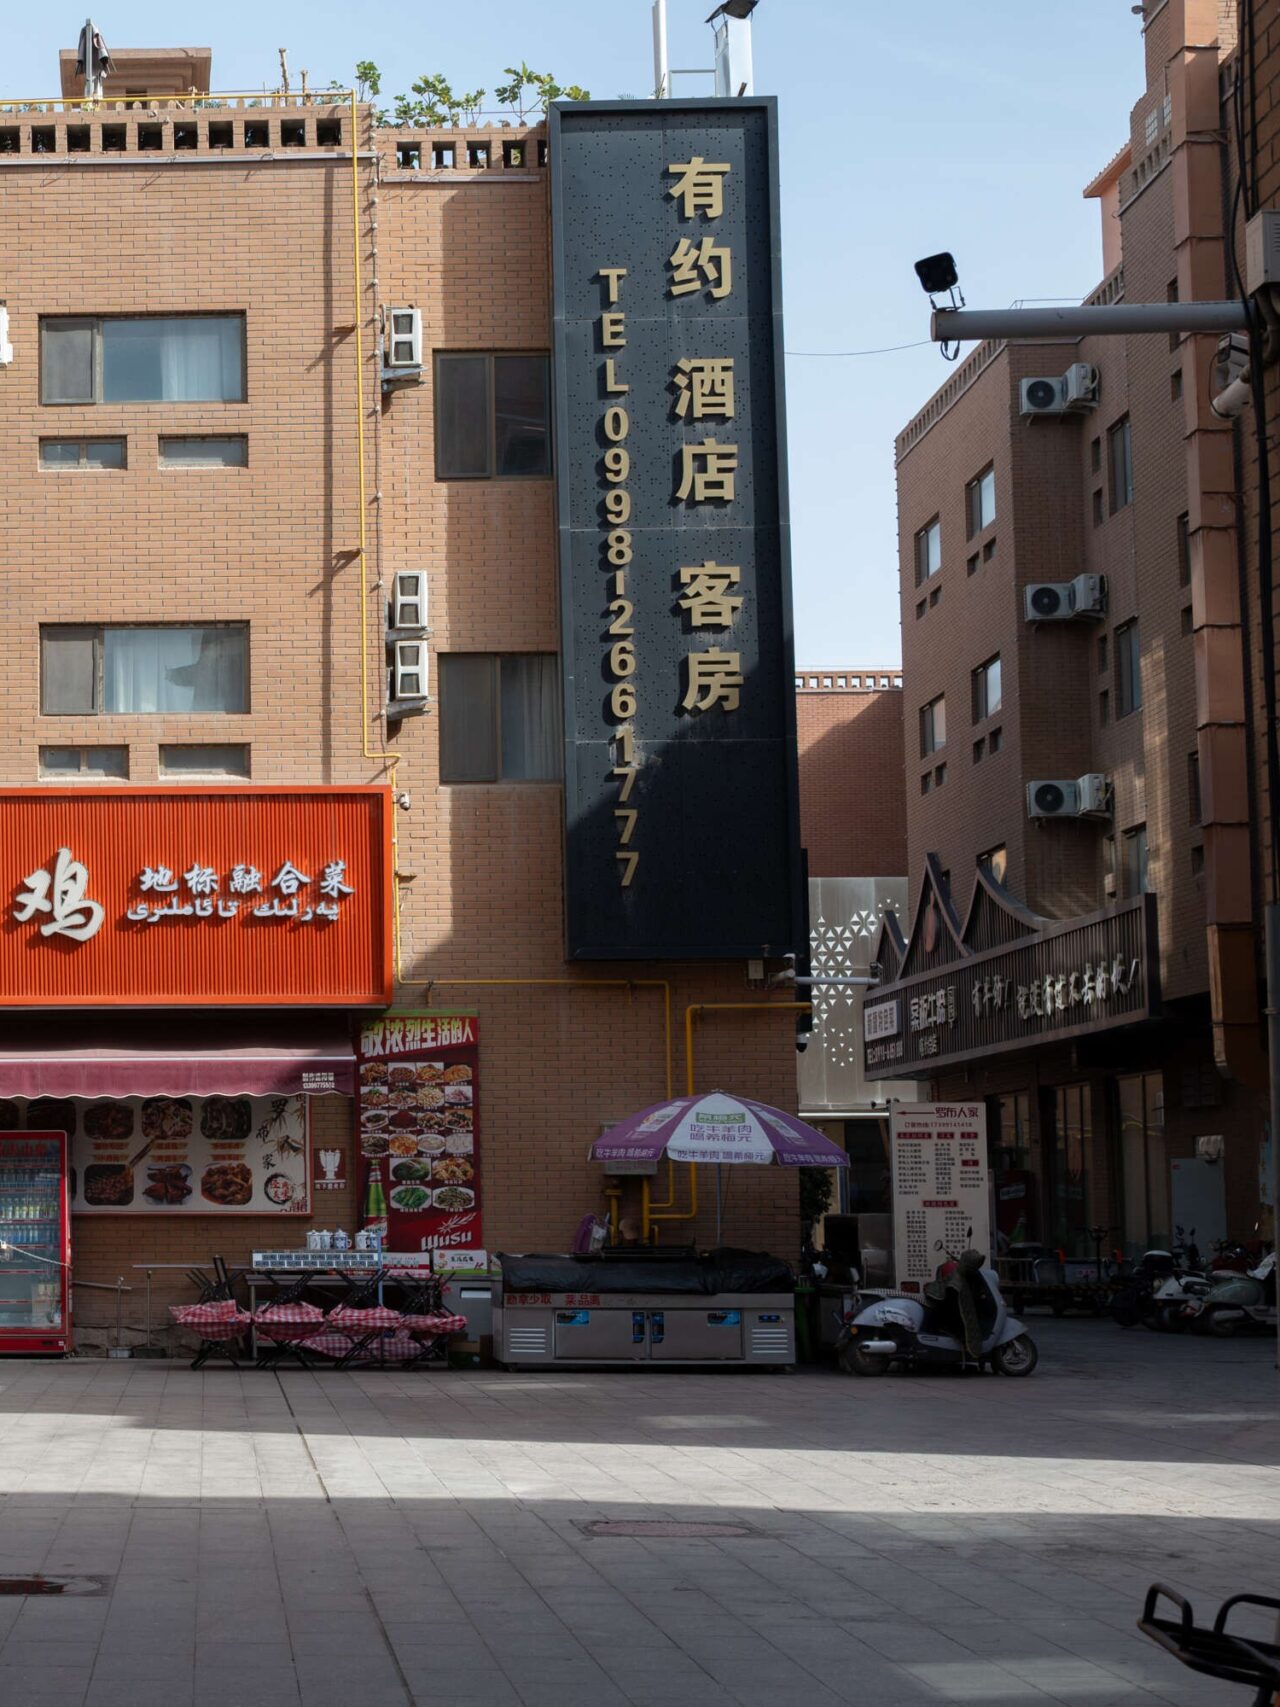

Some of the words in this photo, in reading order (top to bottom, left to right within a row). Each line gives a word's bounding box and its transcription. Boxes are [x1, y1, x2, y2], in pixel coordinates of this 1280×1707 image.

[139, 860, 355, 899] 地标融合菜
[690, 1124, 752, 1134] 吃牛羊肉
